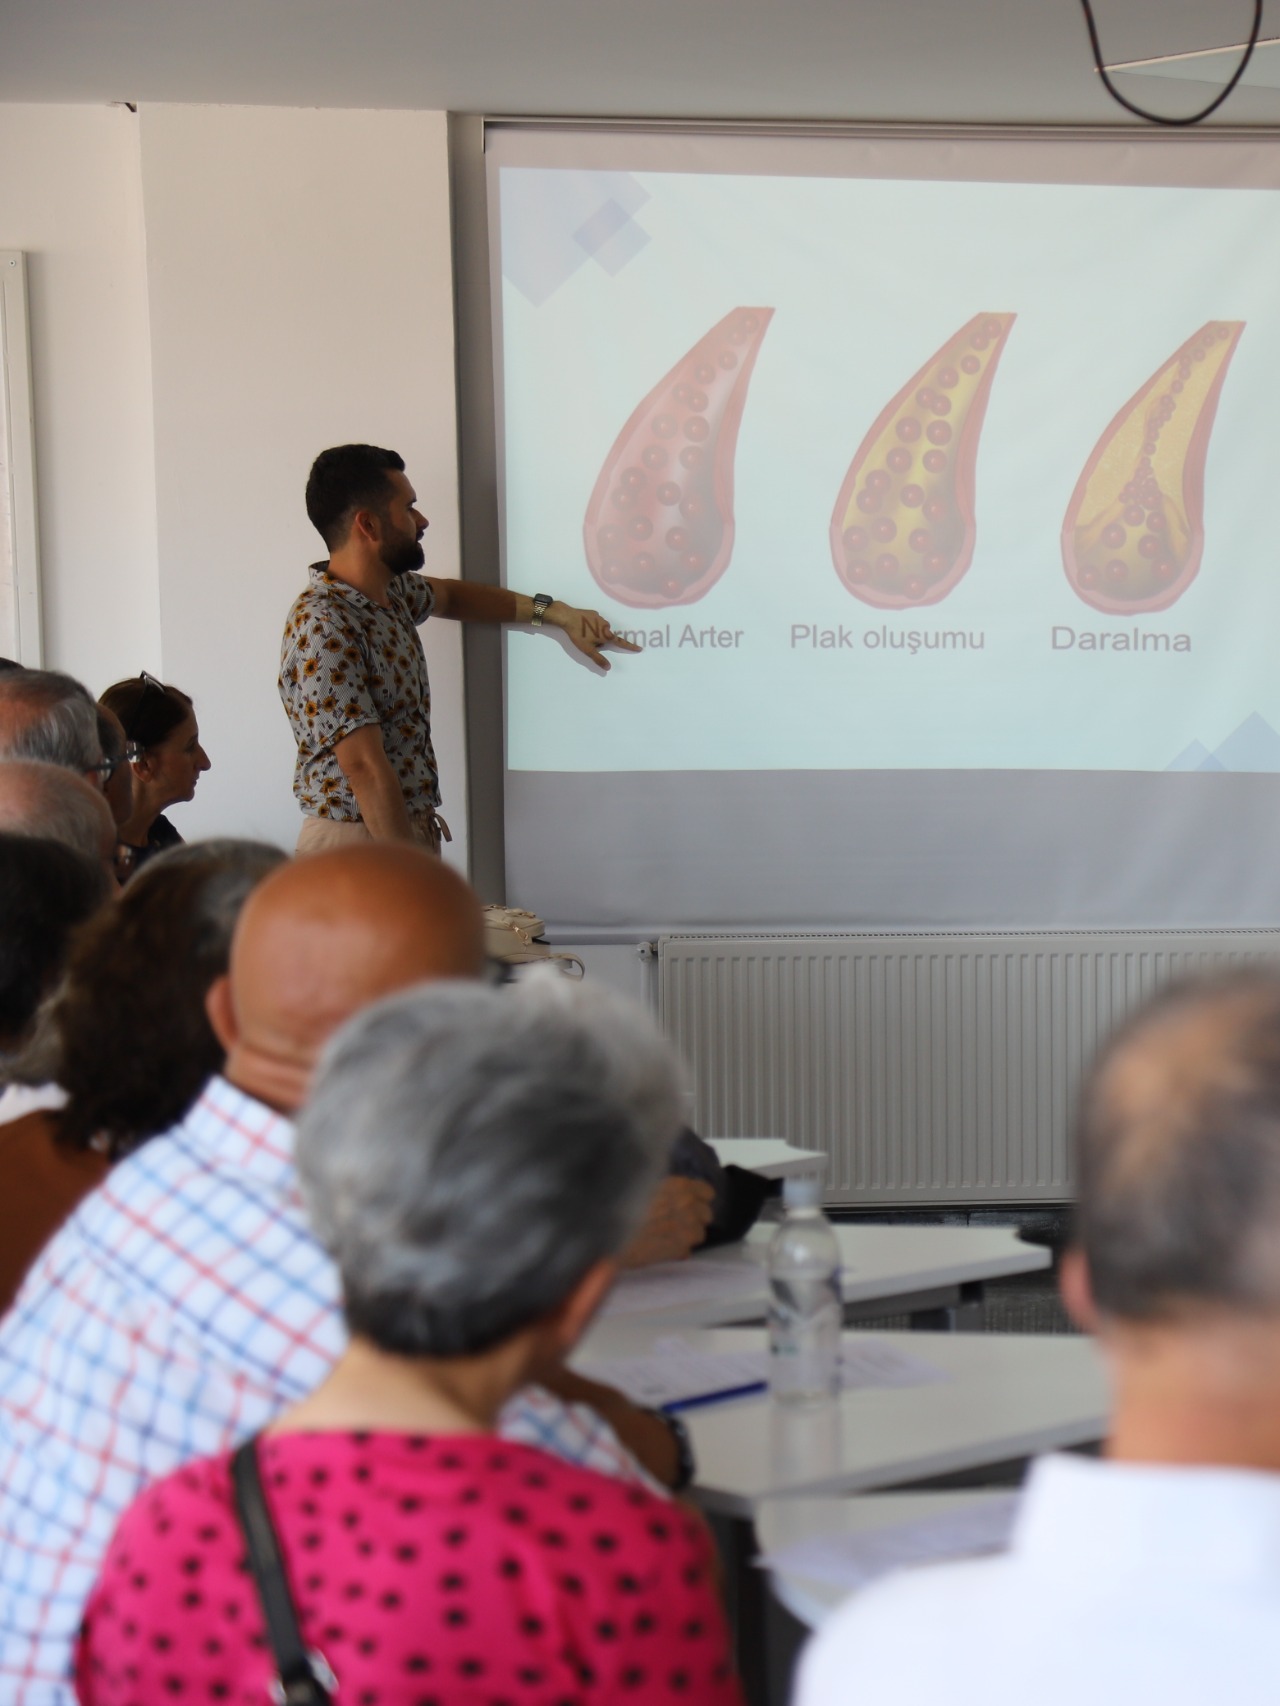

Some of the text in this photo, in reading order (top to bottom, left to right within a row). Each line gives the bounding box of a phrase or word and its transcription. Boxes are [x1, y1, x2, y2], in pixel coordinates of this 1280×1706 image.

[678, 624, 744, 648] Arter
[790, 624, 985, 655] Plak oluşumu
[1051, 625, 1192, 652] Daralma
